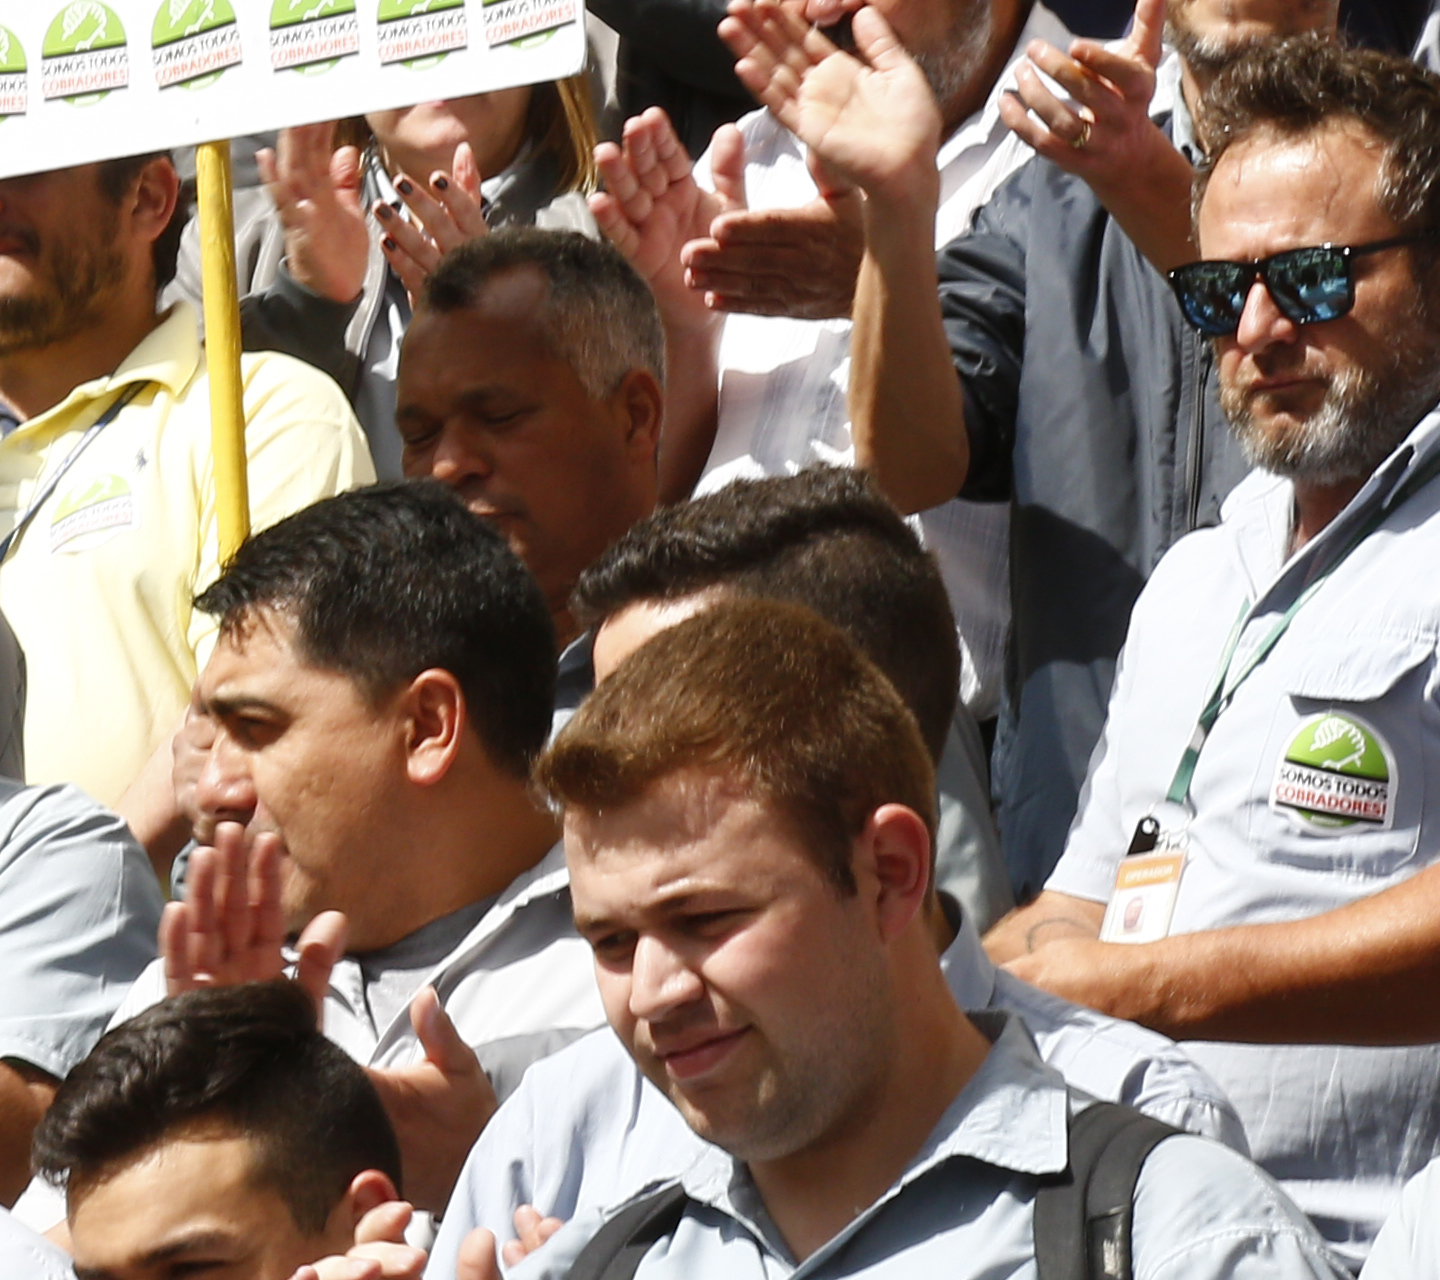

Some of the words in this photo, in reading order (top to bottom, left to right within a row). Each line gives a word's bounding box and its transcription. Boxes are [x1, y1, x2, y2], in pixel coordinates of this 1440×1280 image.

[377, 21, 421, 41] SOMOS
[424, 12, 467, 33] TODOS
[483, 0, 529, 25] SOMOS
[153, 43, 197, 67] SOMOS
[199, 29, 240, 54] TODOS
[270, 27, 314, 48] SOMOS
[318, 19, 358, 38] TODOS
[42, 57, 86, 77] SOMOS
[89, 51, 129, 69] TODOS
[1281, 765, 1332, 790] SOMOS
[1336, 780, 1388, 800] TODOS
